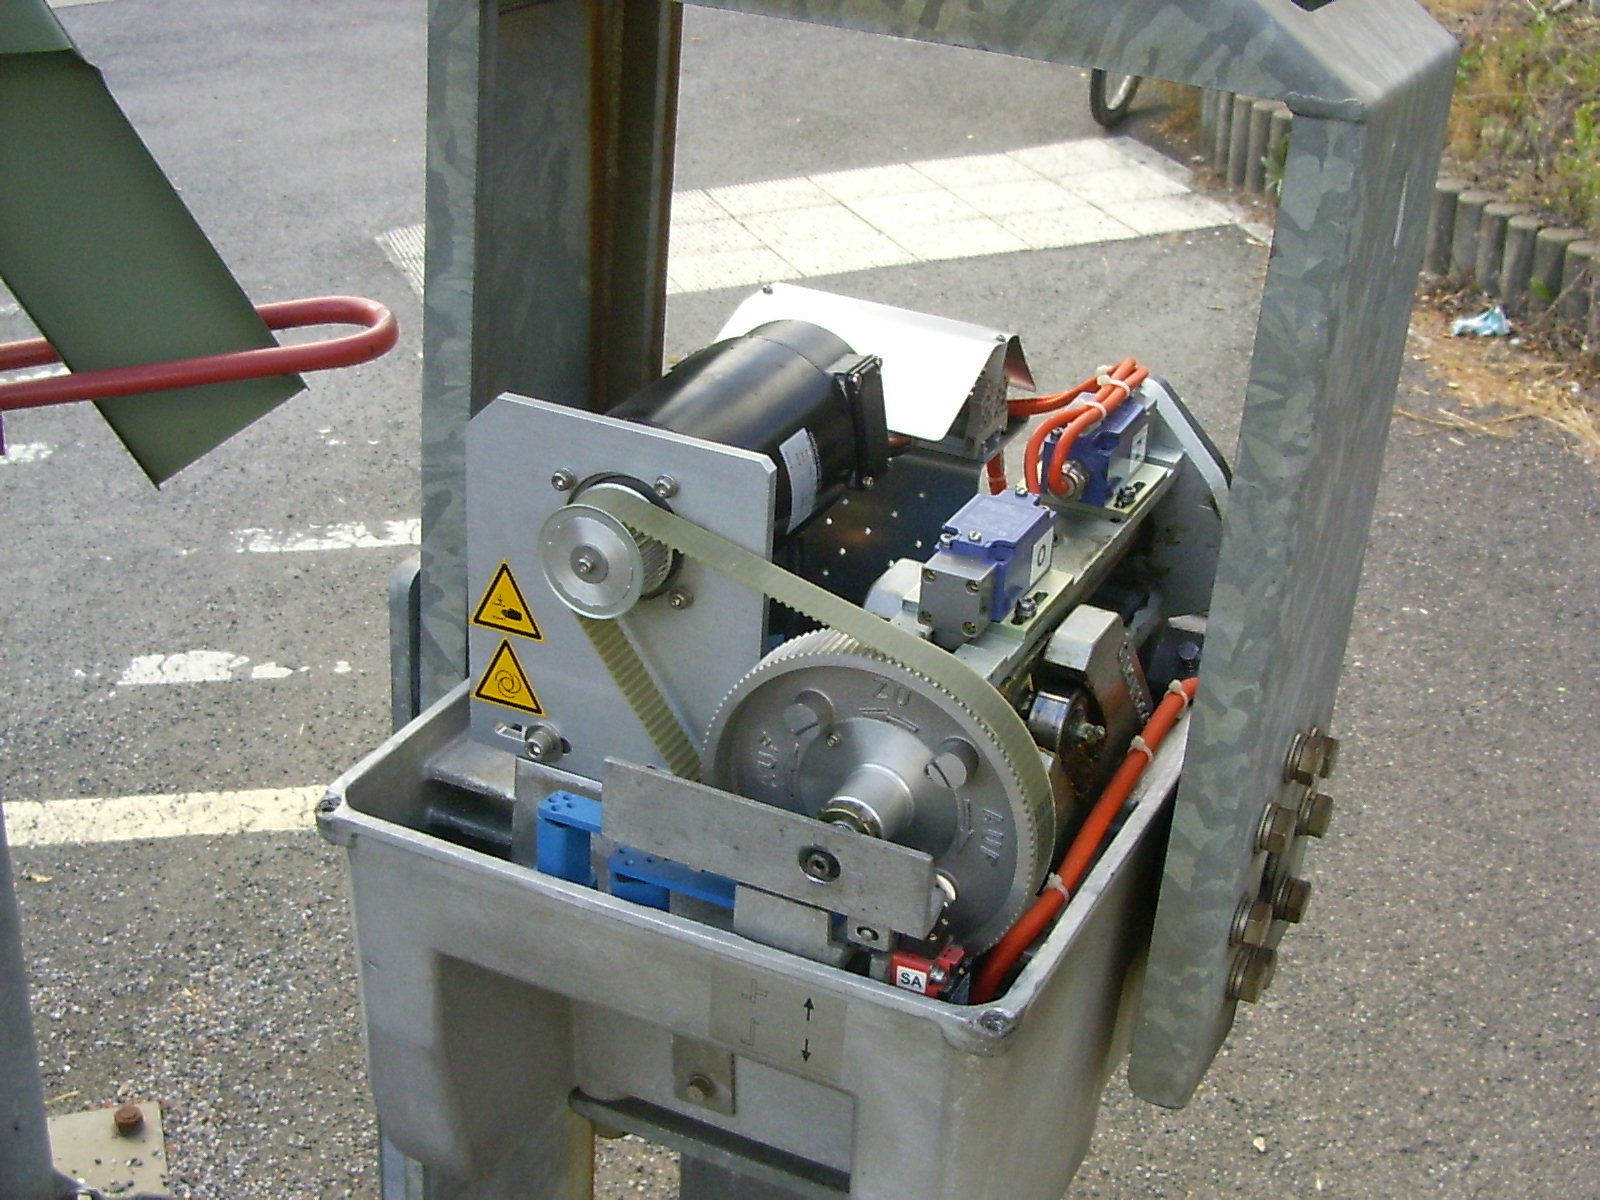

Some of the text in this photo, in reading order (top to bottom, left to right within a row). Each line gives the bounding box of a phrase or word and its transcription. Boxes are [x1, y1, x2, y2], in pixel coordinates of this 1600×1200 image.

[872, 678, 913, 707] ZU
[979, 807, 1006, 866] AUF
[900, 972, 922, 988] SA
